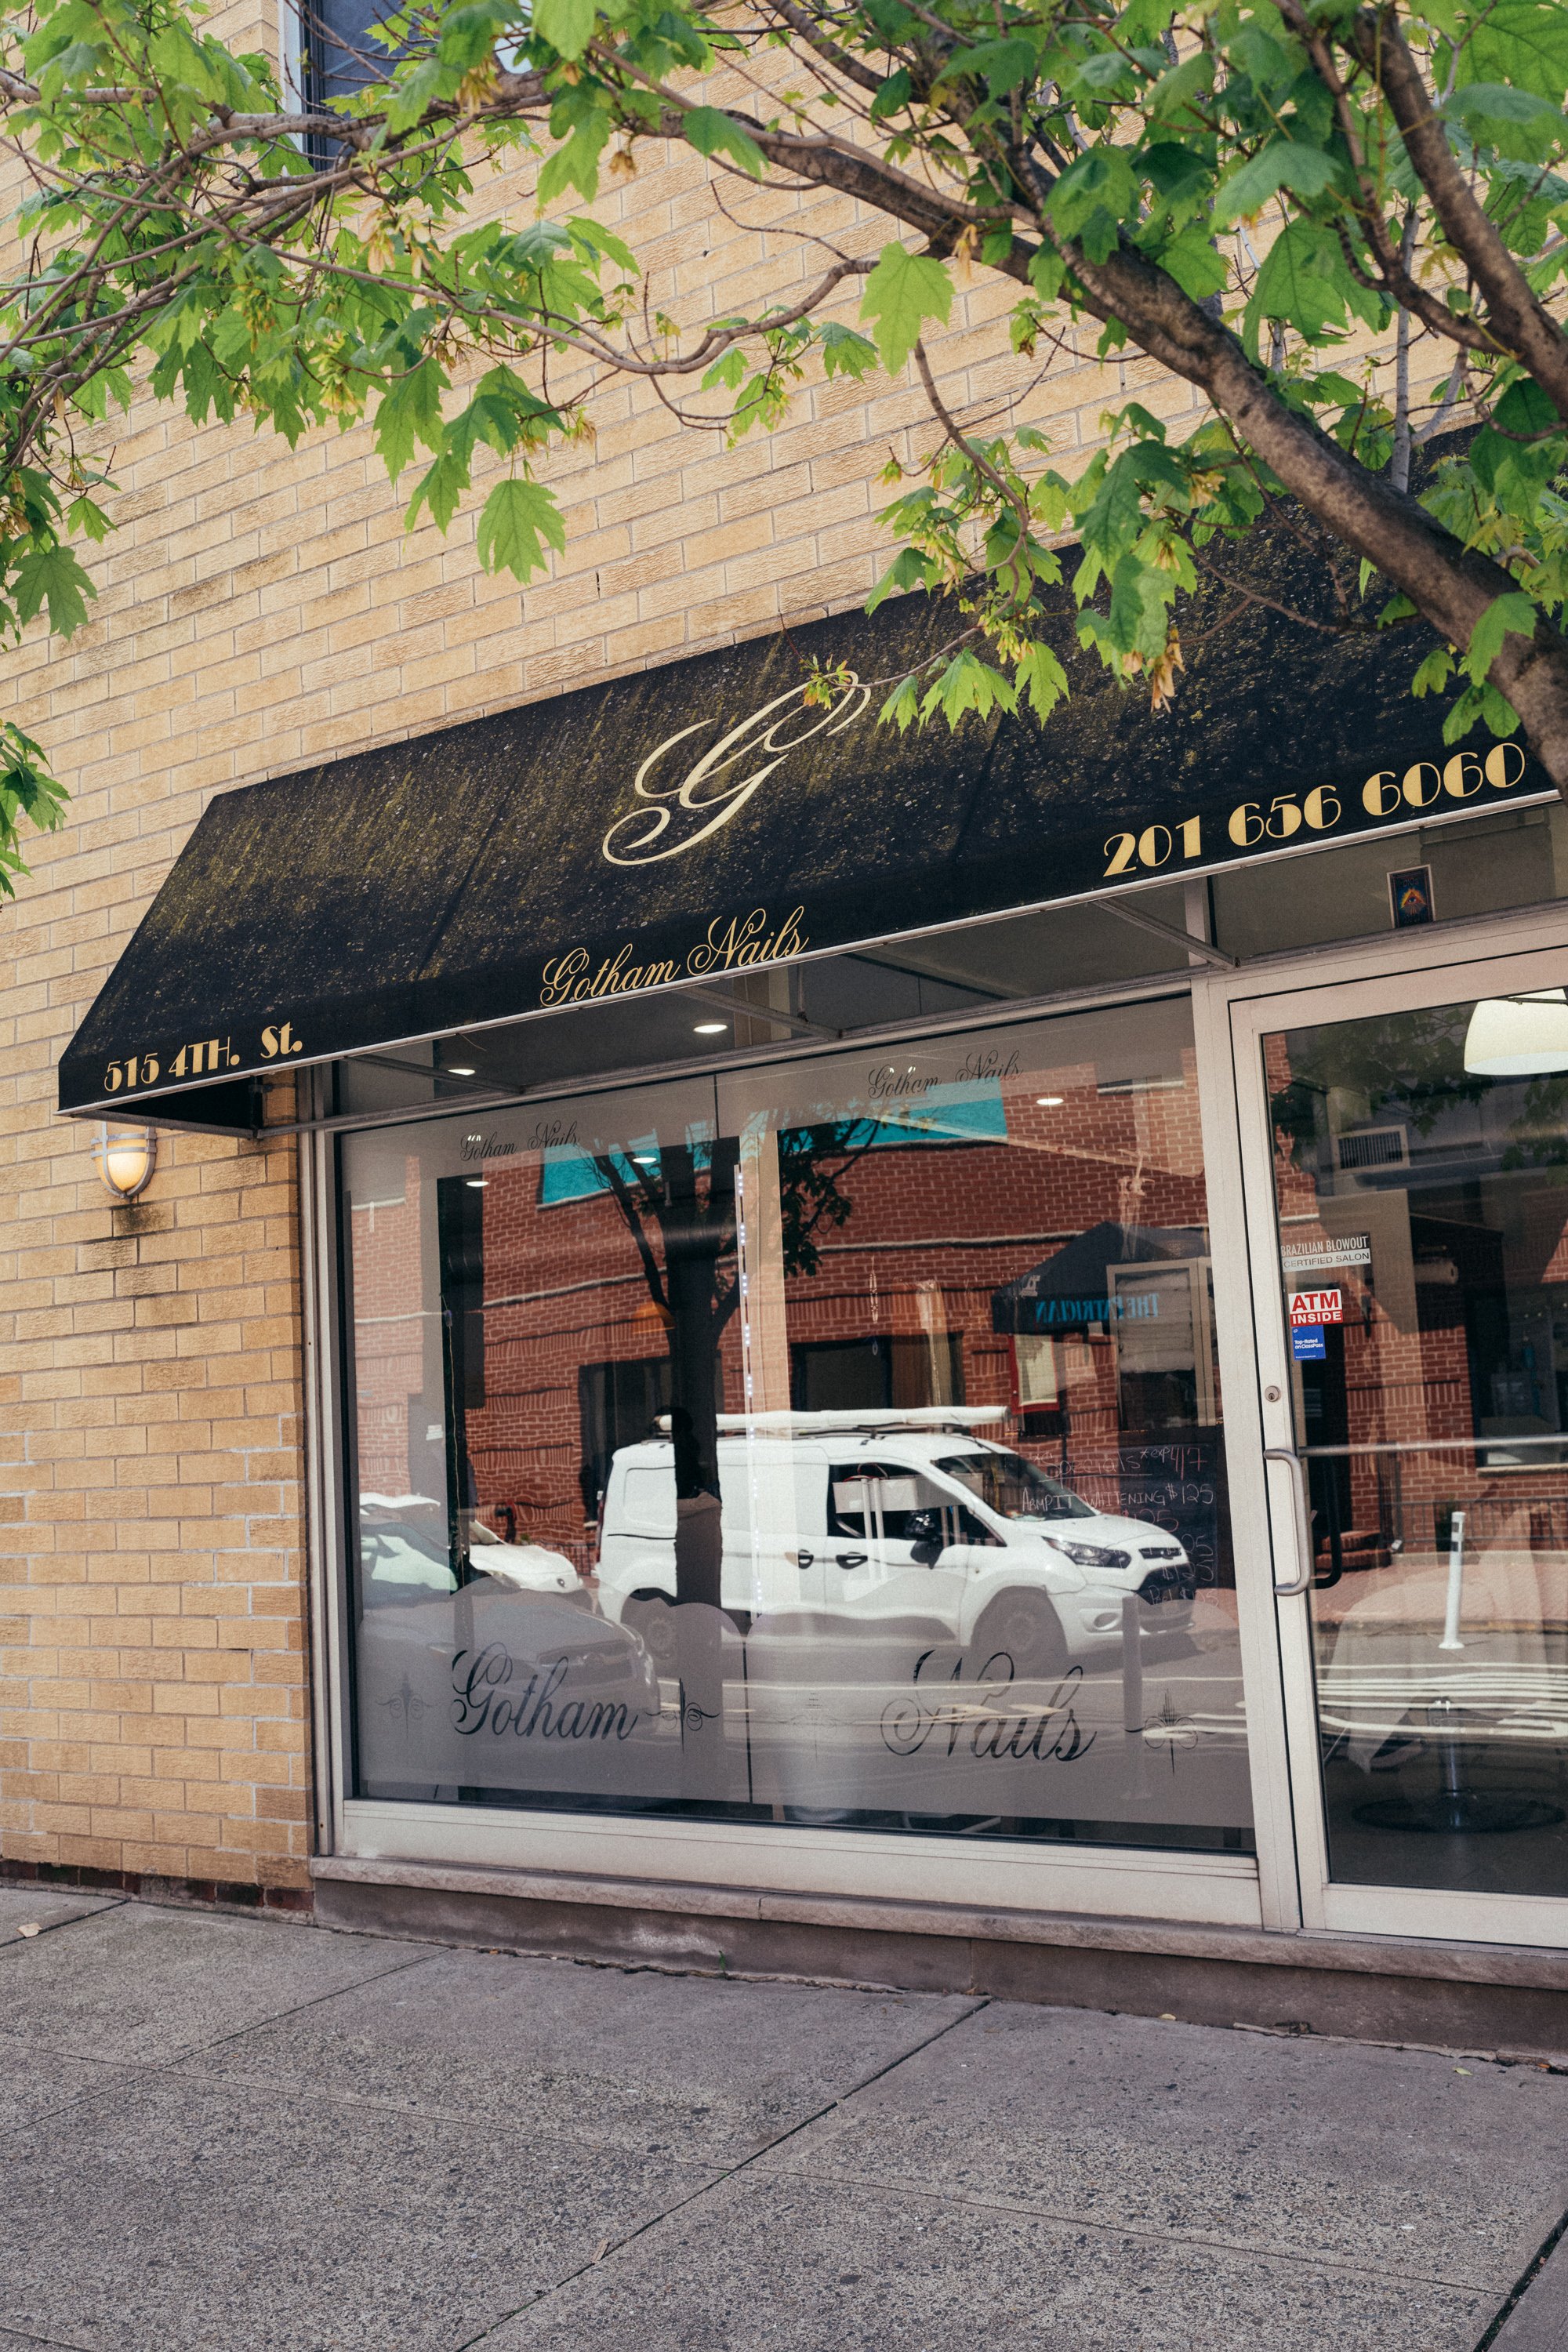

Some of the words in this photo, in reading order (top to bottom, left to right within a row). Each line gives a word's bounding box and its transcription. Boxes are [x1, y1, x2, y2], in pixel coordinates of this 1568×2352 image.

[602, 670, 871, 865] G
[1102, 815, 1201, 877] 201
[1228, 785, 1341, 846] 656
[1362, 742, 1526, 816] 6060
[539, 943, 681, 1007] Gotham
[687, 906, 809, 976] Nails
[104, 1053, 159, 1092] 515
[169, 1036, 240, 1077] 4TH.
[260, 1022, 303, 1058] St.
[868, 1064, 942, 1099] Gotham
[955, 1050, 1024, 1086] Nails
[459, 1130, 517, 1161] Gotham
[527, 1120, 579, 1151] Nails
[1281, 1241, 1323, 1256] BRAZILIAN
[1326, 1236, 1368, 1252] BLOWOUT
[1283, 1256, 1333, 1268] CERTIFIED
[1336, 1253, 1370, 1263] SALON
[1292, 1292, 1338, 1312] ATM
[1293, 1311, 1341, 1324] INSIDE
[1165, 1483, 1214, 1504] $125
[448, 1642, 639, 1740] Gotham
[880, 1649, 1098, 1762] Nails
